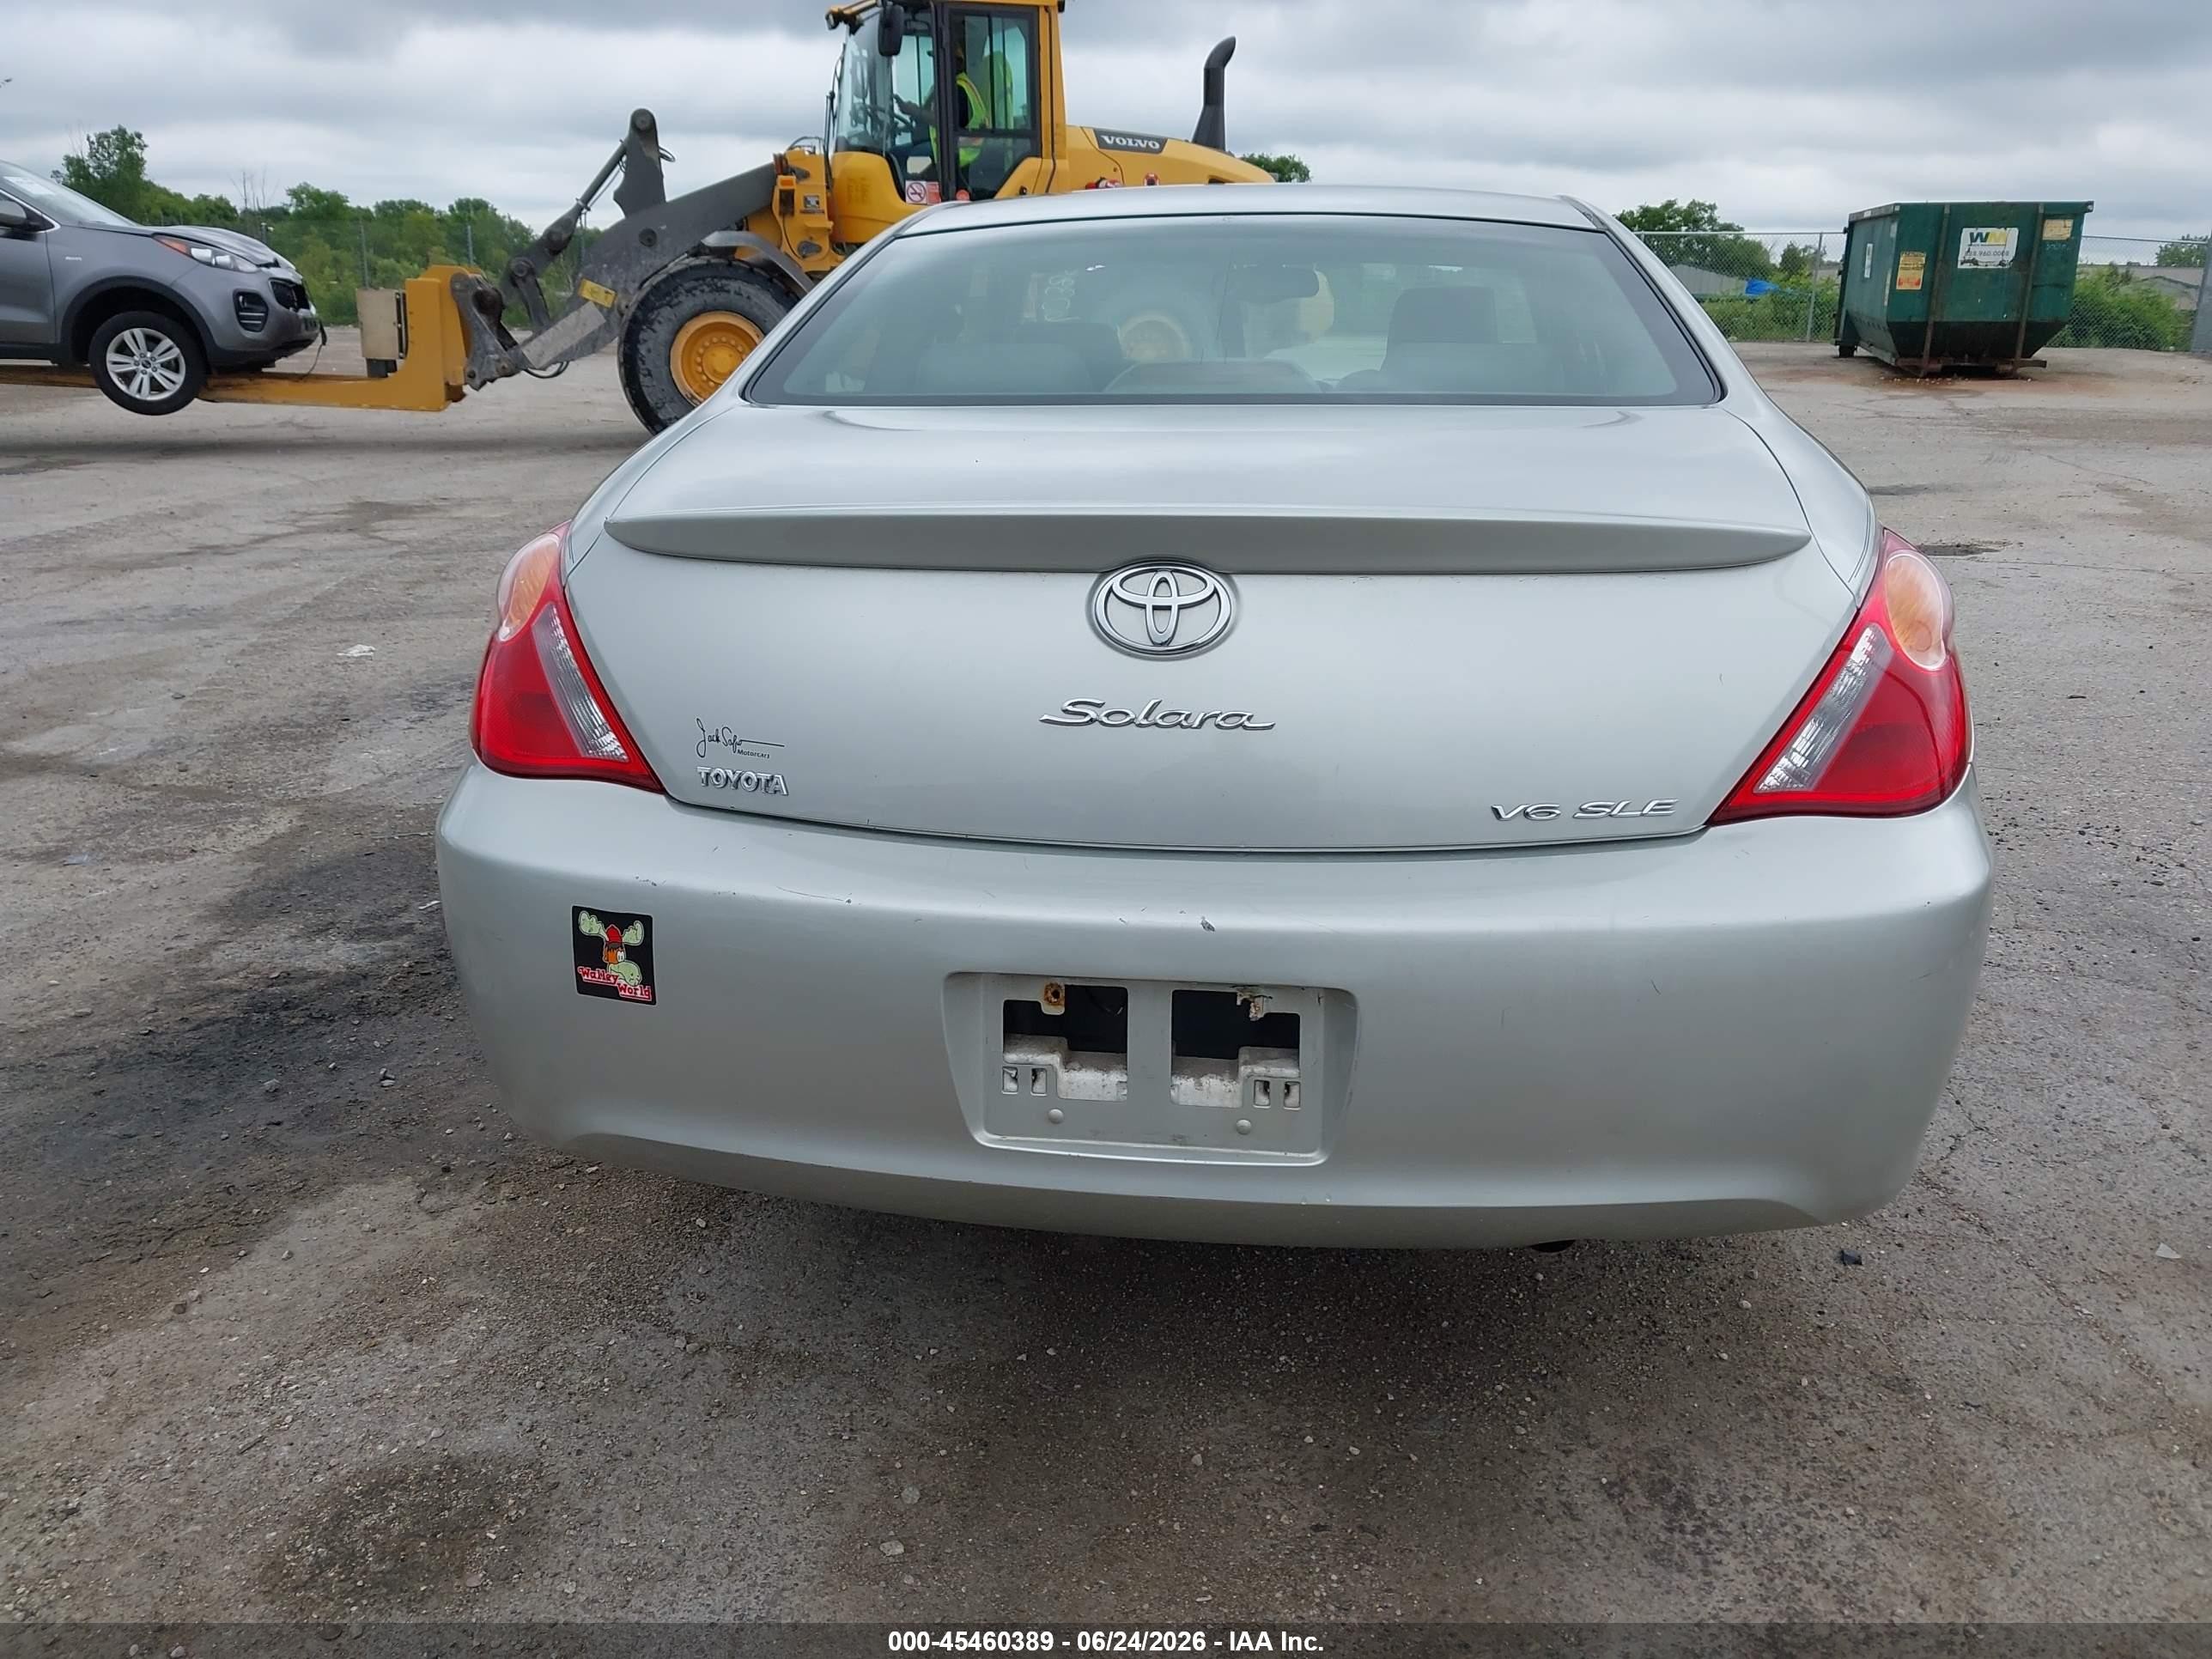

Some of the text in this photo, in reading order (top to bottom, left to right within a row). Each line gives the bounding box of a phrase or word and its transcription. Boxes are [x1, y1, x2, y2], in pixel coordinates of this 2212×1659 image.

[1100, 135, 1160, 149] VOLVO
[1039, 697, 1276, 730] Solara
[696, 718, 720, 758] Jack
[738, 749, 770, 759] Motorcars
[696, 766, 789, 796] TOYOTA
[1491, 799, 1679, 821] V6 SLE
[578, 967, 618, 986] Walley
[617, 982, 652, 999] World
